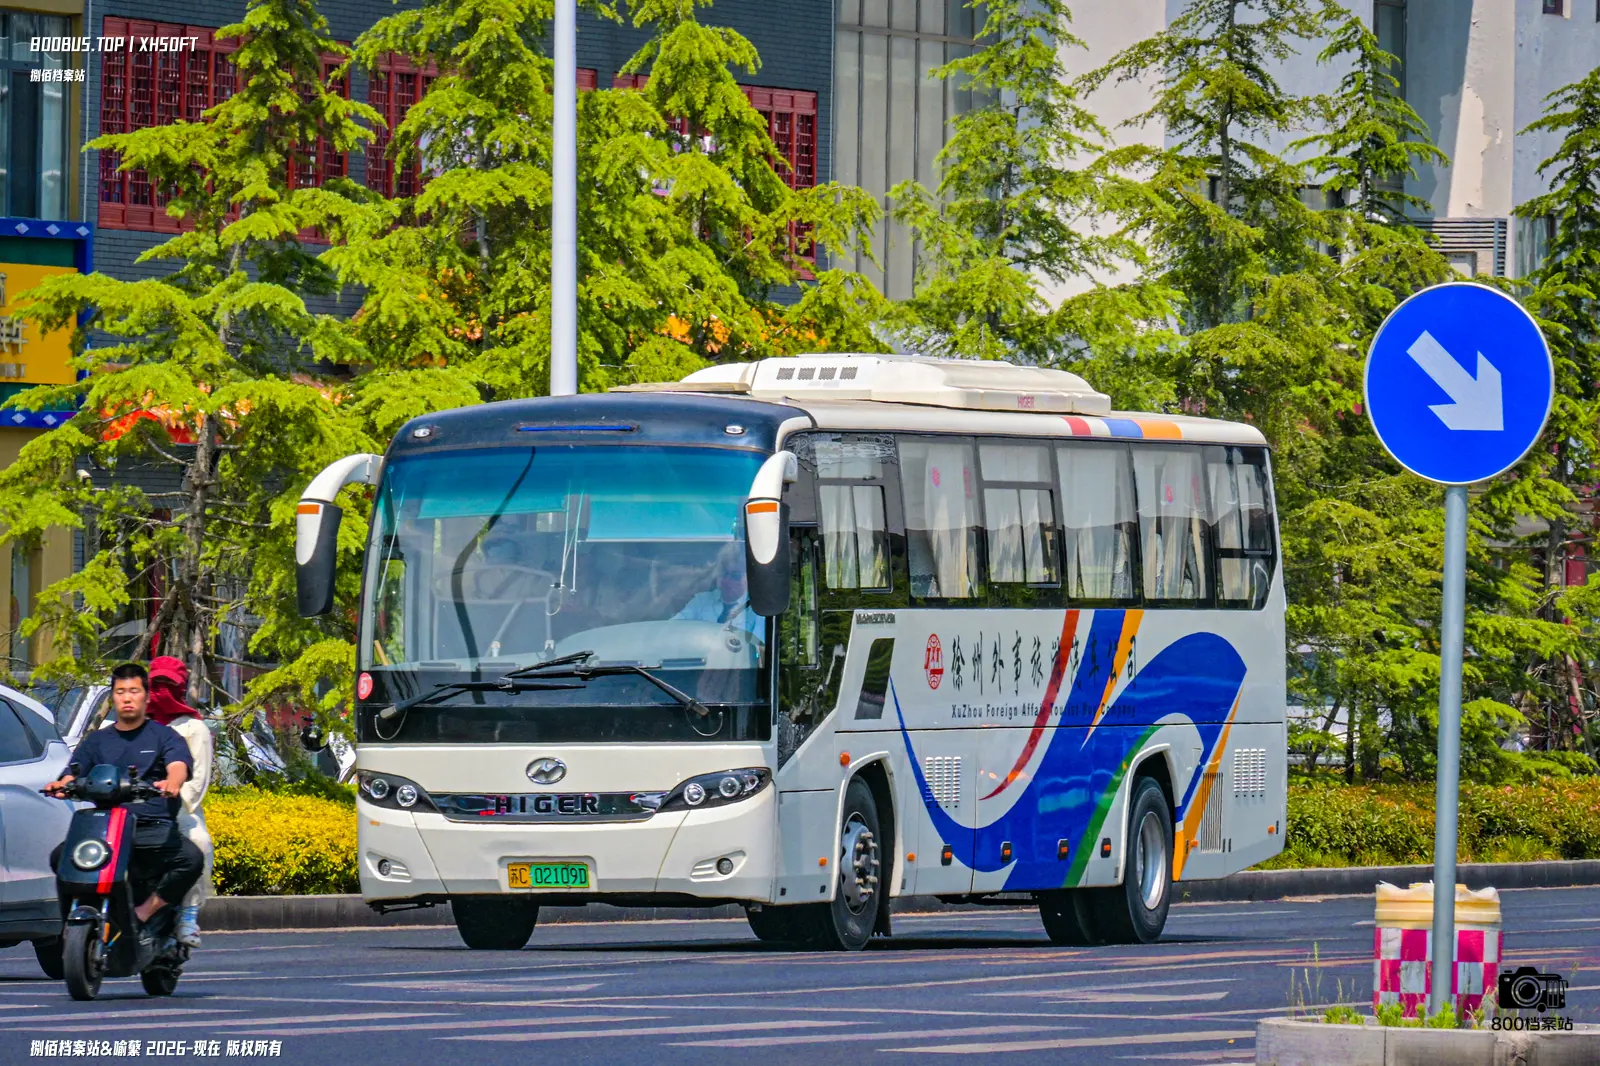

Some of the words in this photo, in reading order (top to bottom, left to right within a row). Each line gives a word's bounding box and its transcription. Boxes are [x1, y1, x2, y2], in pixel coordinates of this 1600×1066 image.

[951, 704, 983, 719] XuZhou
[986, 704, 1018, 720] Foreign
[1100, 702, 1137, 718] Company
[494, 795, 599, 815] HIGER
